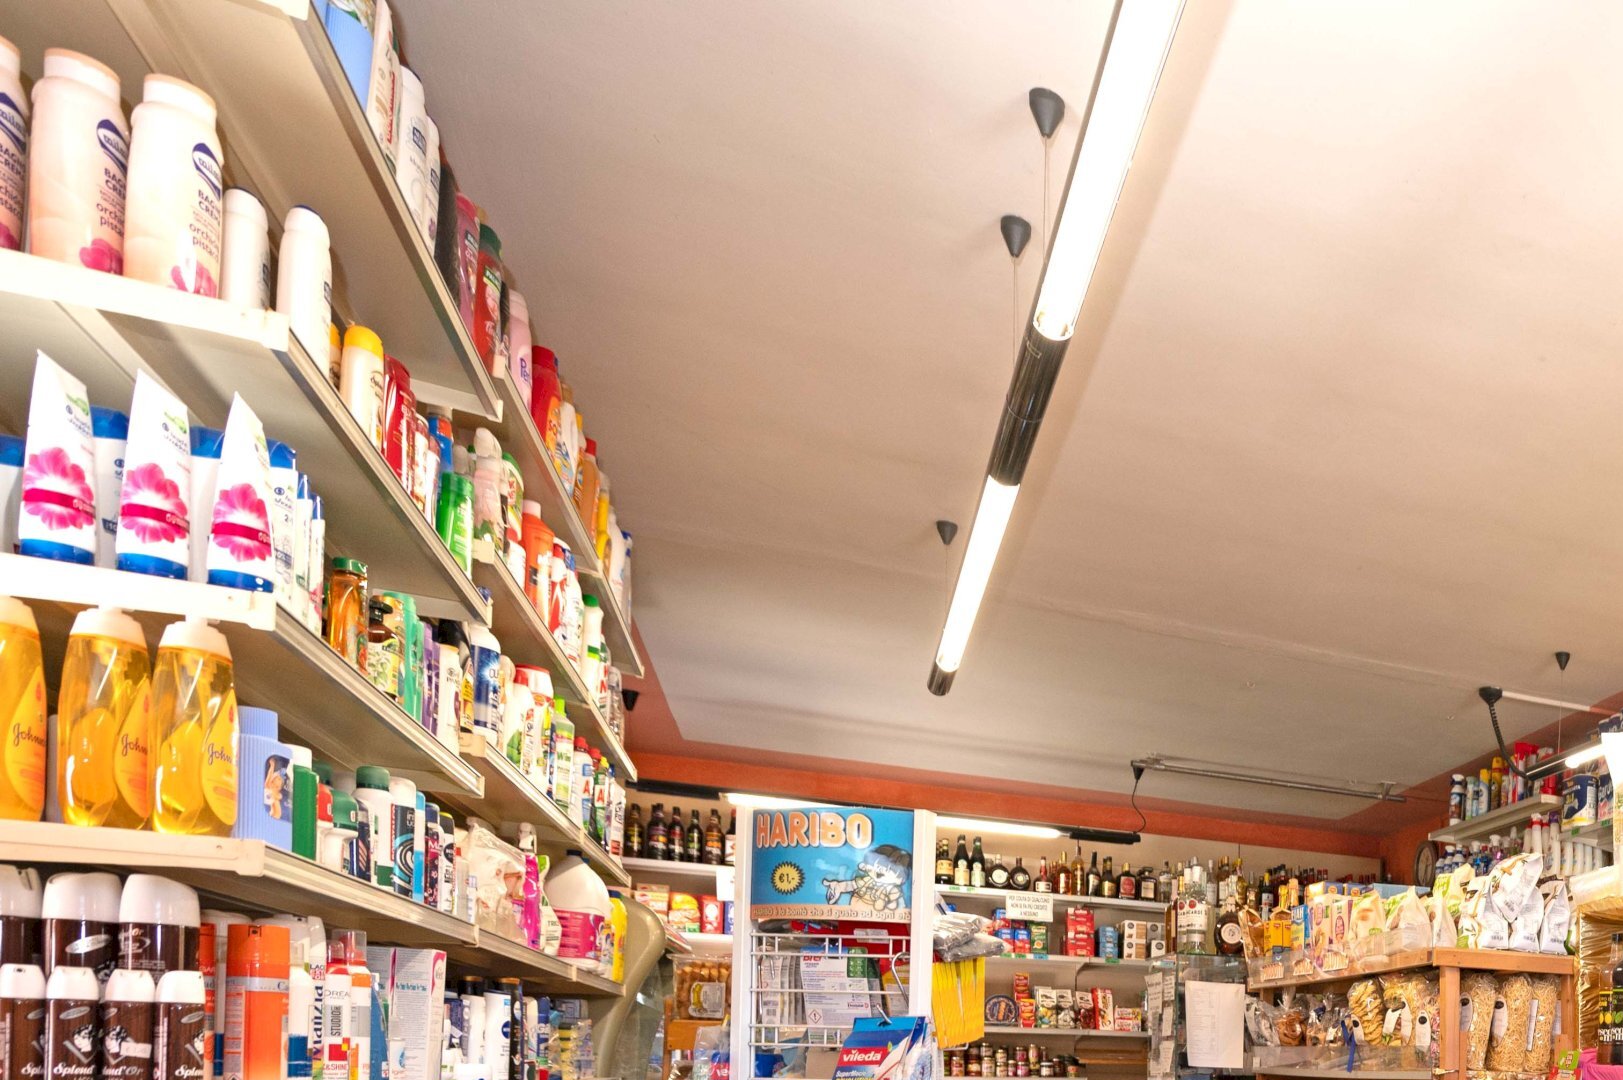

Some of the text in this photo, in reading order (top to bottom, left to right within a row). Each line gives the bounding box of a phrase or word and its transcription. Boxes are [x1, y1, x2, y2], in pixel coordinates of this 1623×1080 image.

[755, 811, 873, 850] HARIBO
[786, 907, 807, 917] bontà
[810, 908, 824, 917] che
[834, 909, 858, 920] gusta
[861, 910, 872, 918] ad
[875, 911, 895, 921] ogni
[842, 1049, 884, 1063] vileda
